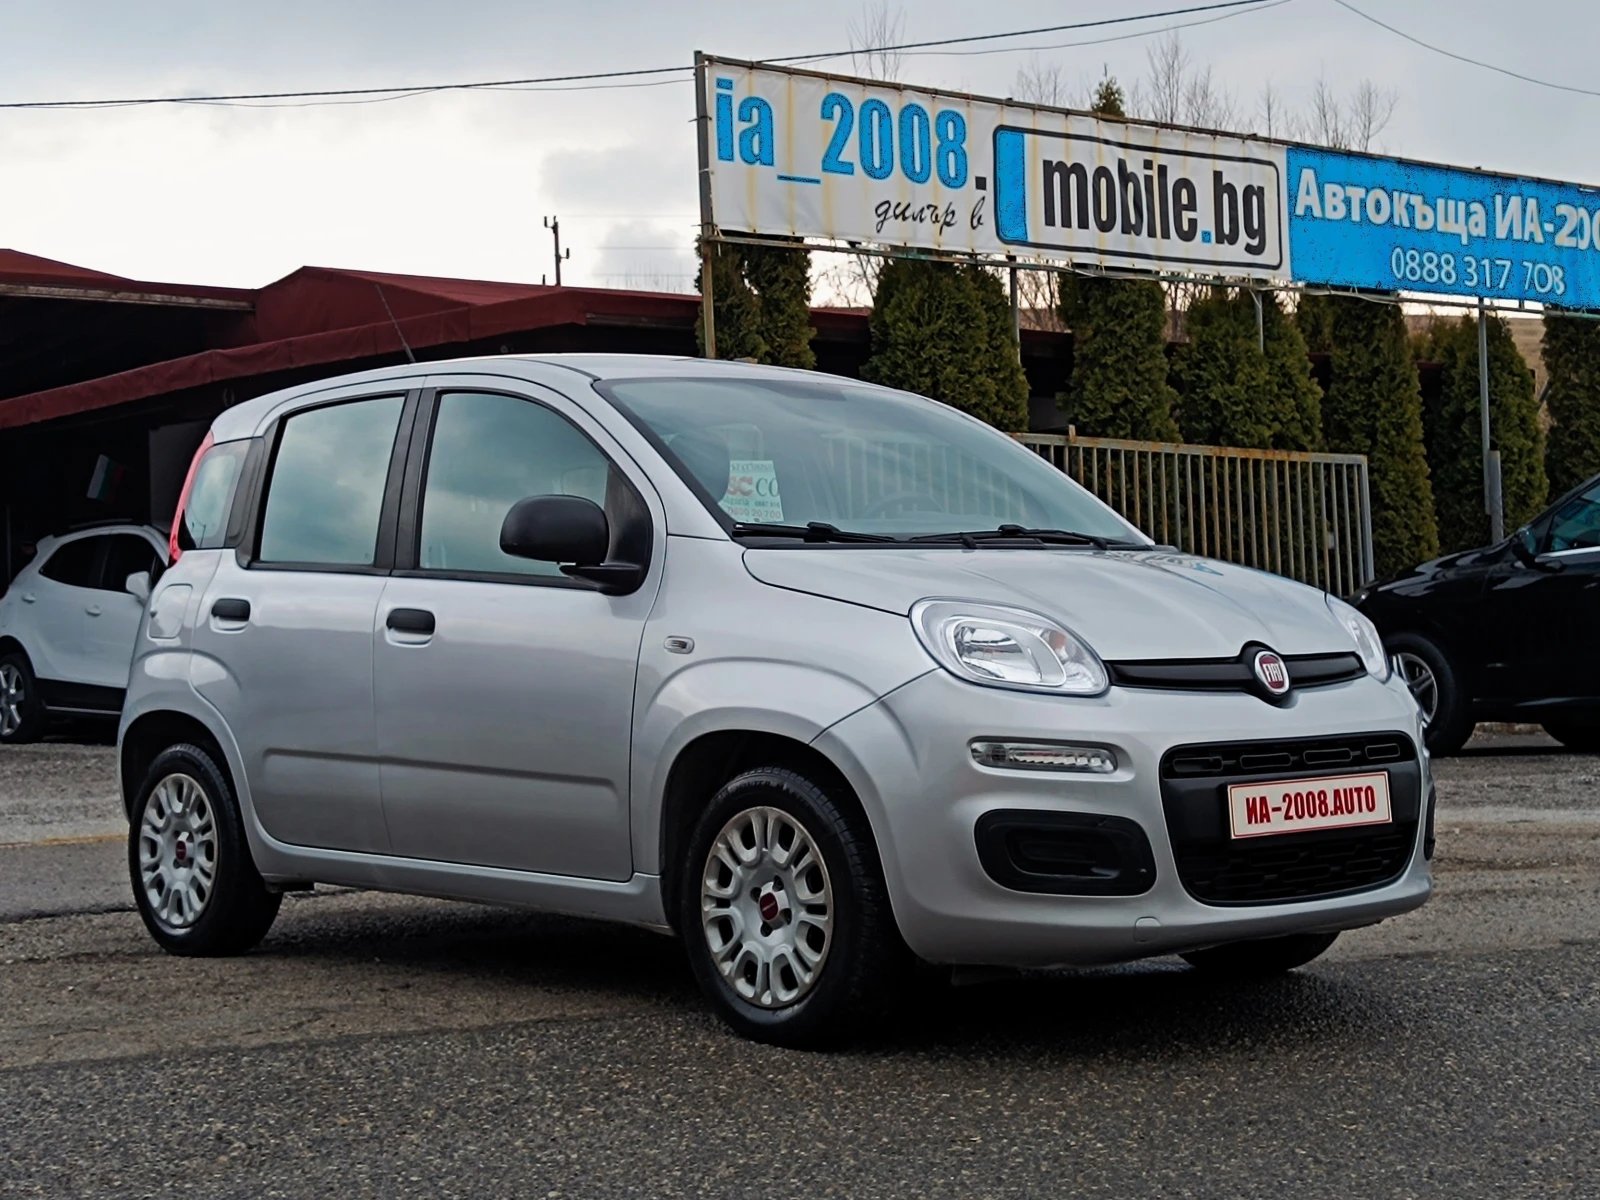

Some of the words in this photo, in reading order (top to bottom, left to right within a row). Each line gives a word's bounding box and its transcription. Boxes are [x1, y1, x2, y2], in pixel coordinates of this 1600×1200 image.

[875, 199, 958, 235] дилър
[970, 196, 986, 230] в
[1042, 158, 1267, 256] mobile.bg
[1294, 167, 1488, 246] Автокъща
[1391, 247, 1457, 285] 0888
[1463, 255, 1511, 290] 317
[1522, 261, 1566, 295] 708
[1262, 663, 1284, 682] FIAT
